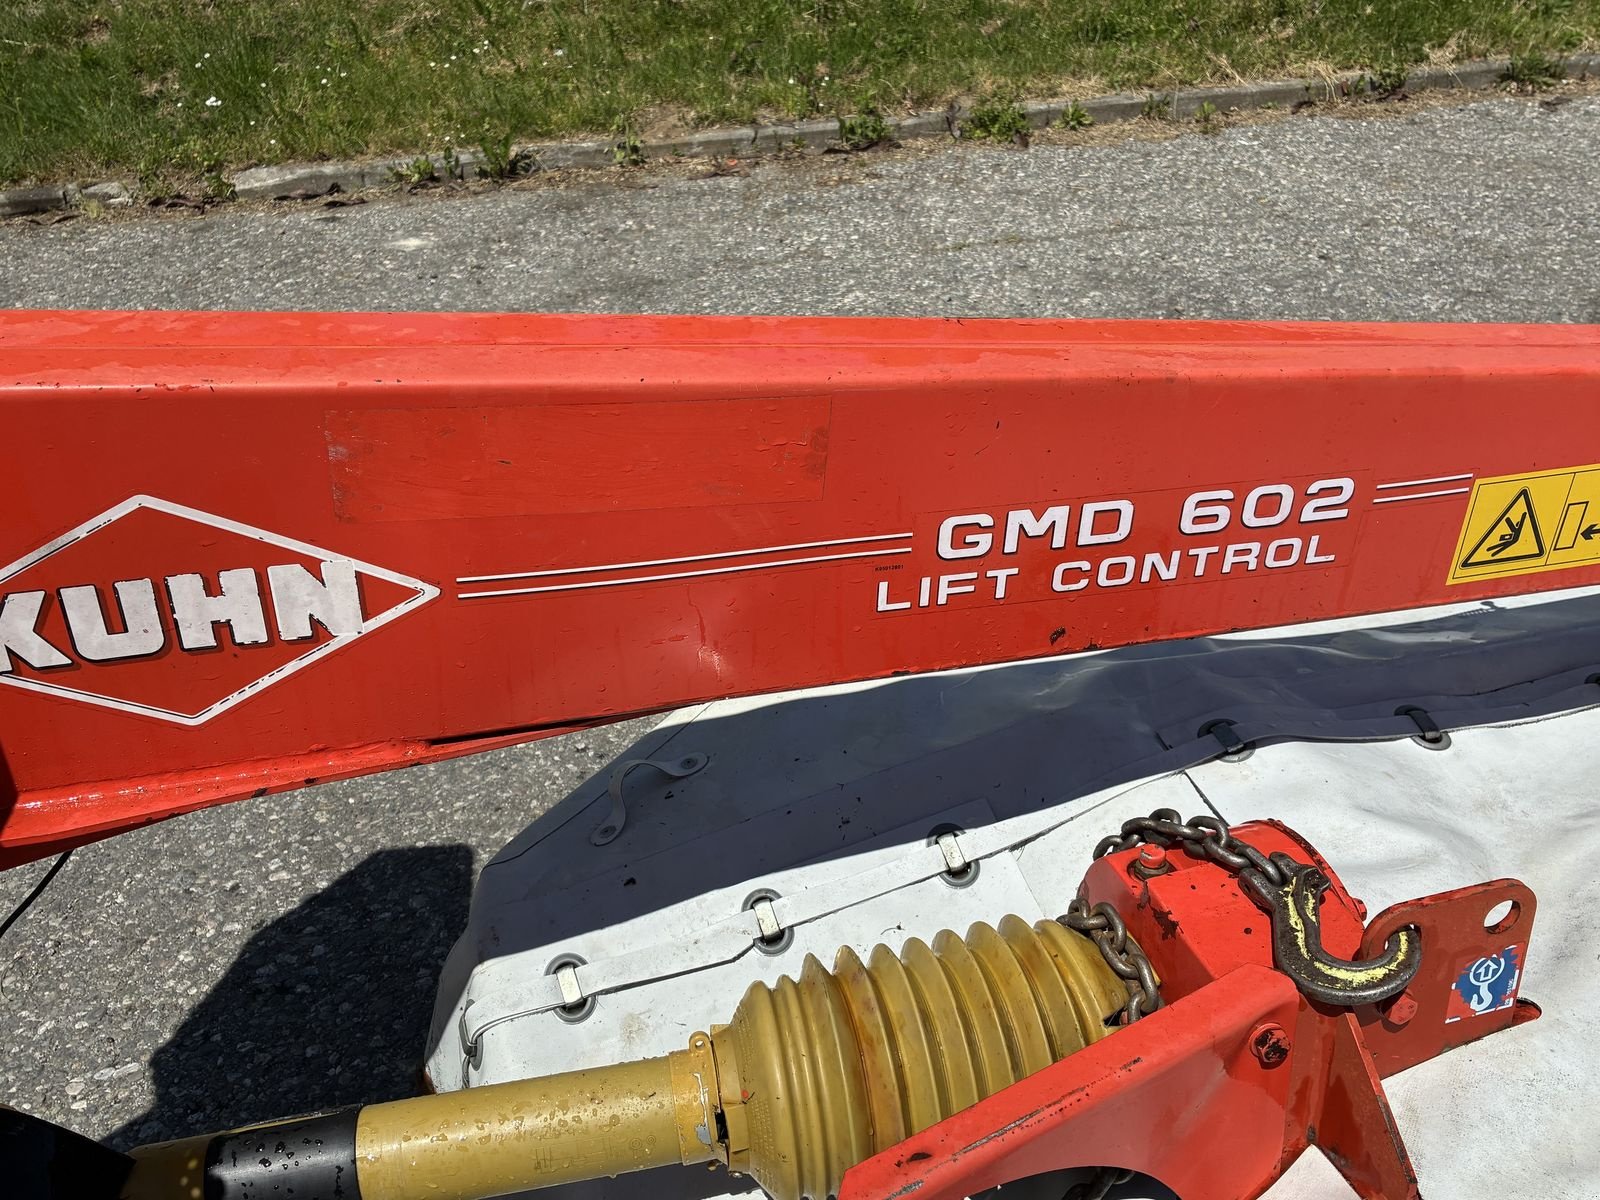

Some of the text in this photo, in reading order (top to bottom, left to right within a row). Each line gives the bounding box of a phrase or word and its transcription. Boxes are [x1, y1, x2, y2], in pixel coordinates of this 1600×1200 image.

[936, 477, 1356, 560] GMD 602
[876, 534, 1337, 613] LIFT CONTROL
[0, 559, 366, 673] KUHN
